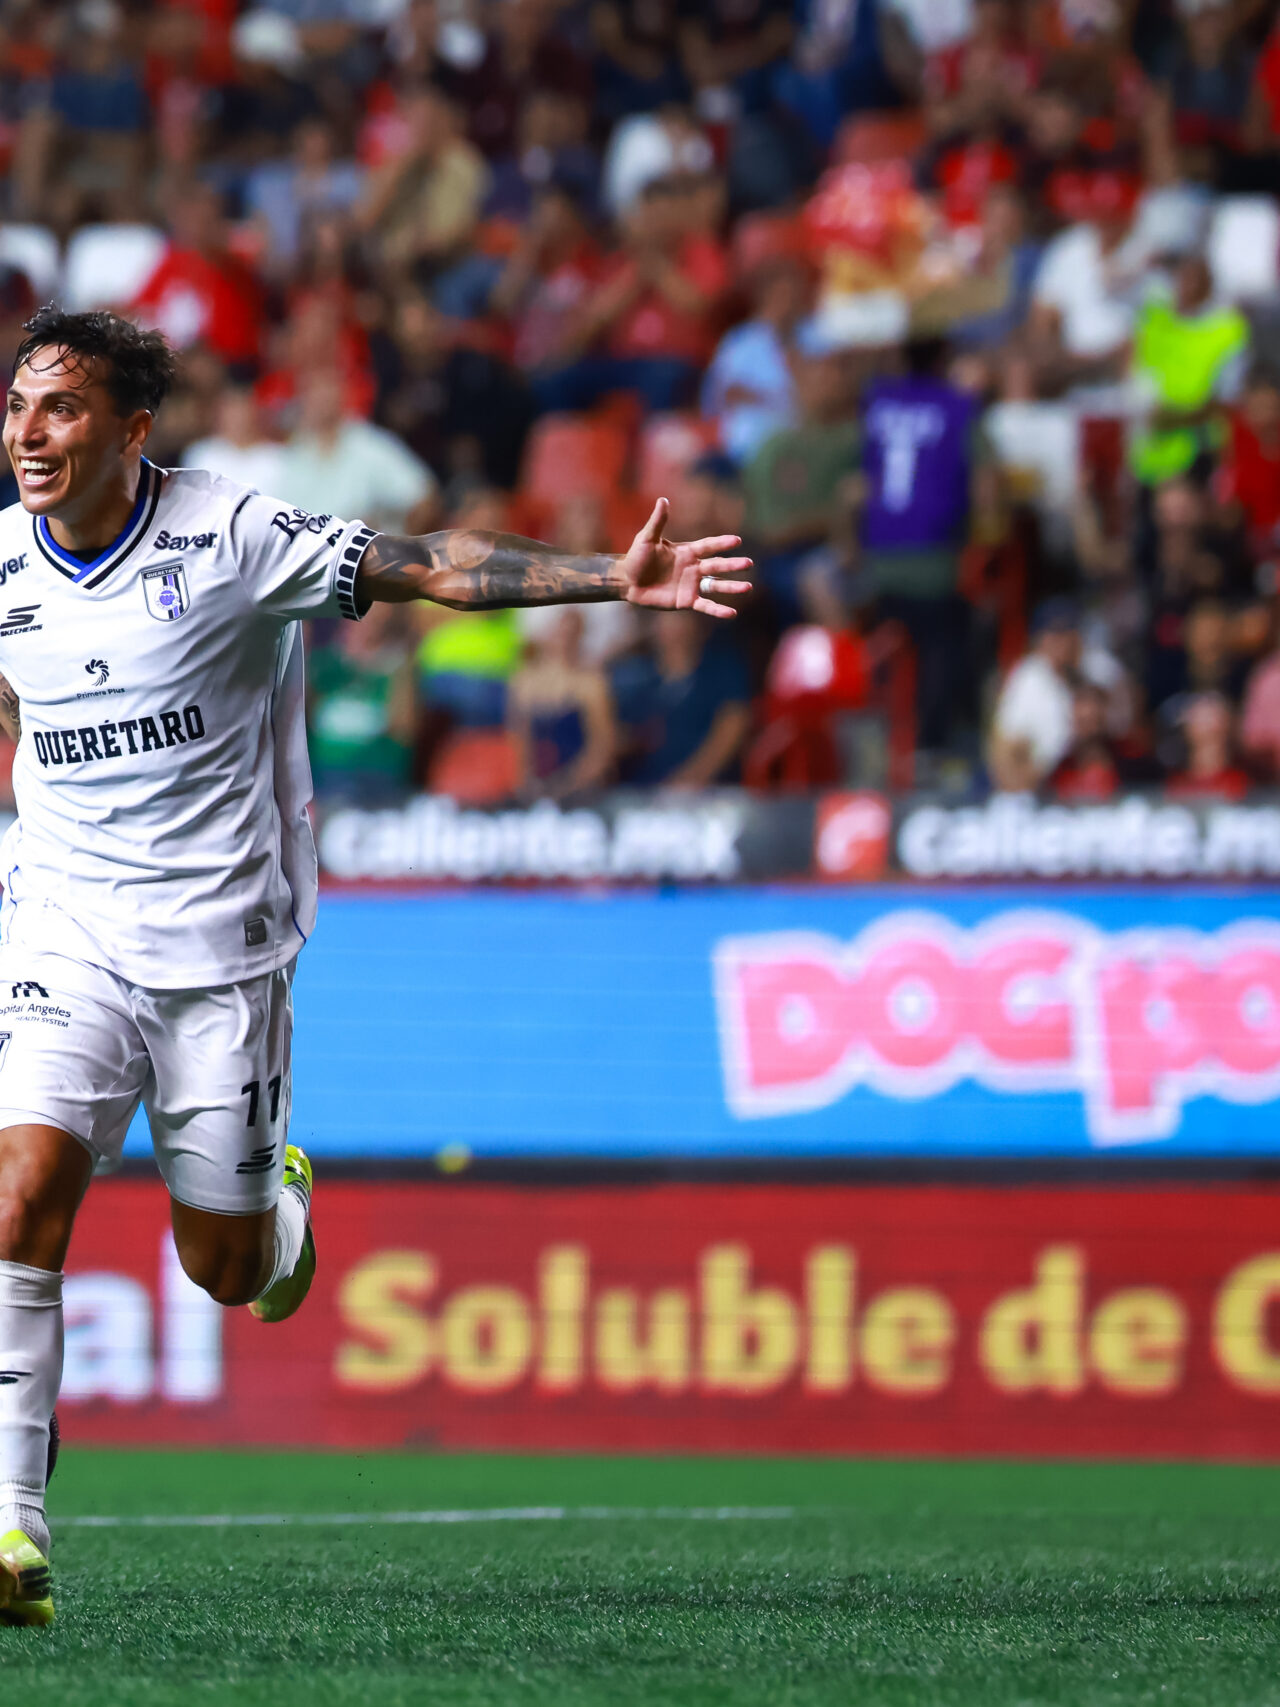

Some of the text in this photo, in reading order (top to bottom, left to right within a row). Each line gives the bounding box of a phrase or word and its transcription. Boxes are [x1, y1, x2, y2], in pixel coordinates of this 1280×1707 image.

[0, 624, 43, 637] SKECHERS
[76, 687, 125, 700] Primera Plus
[33, 704, 206, 768] QUERÉTARO
[27, 1003, 71, 1018] Angeles
[41, 1017, 69, 1028] SYSTEM
[241, 1075, 281, 1127] 11
[333, 1243, 956, 1396] Soluble
[980, 1242, 1188, 1397] de
